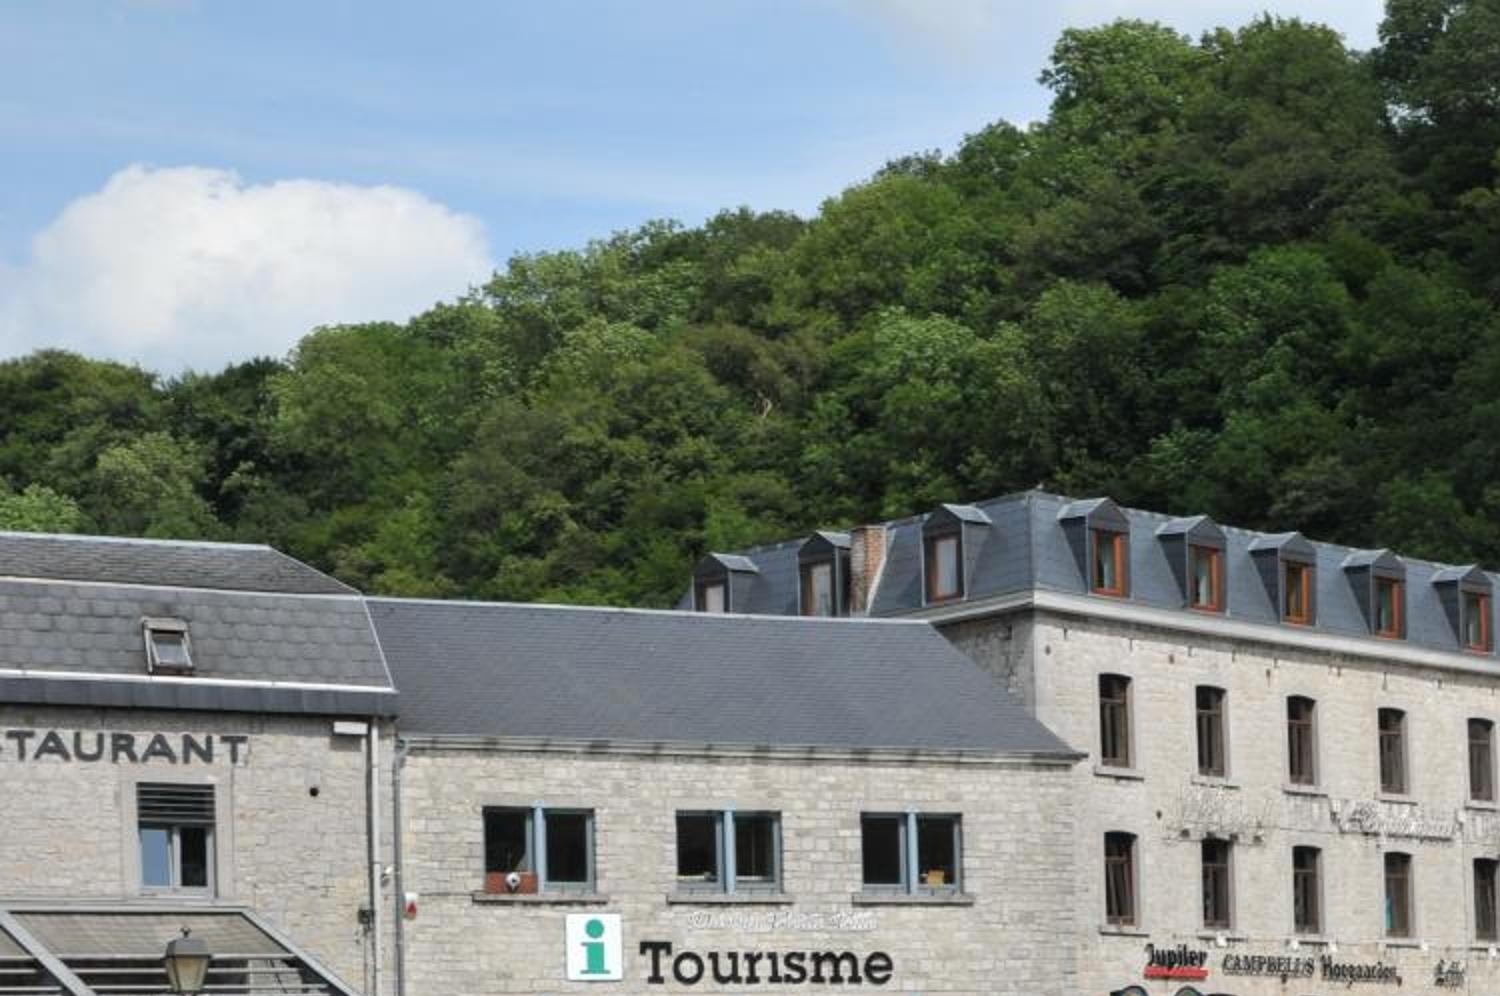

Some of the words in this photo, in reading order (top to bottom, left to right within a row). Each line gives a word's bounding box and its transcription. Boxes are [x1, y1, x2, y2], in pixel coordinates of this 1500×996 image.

[0, 729, 249, 764] TAURANT
[639, 941, 894, 985] Tourisme
[1145, 943, 1208, 969] Jupiler
